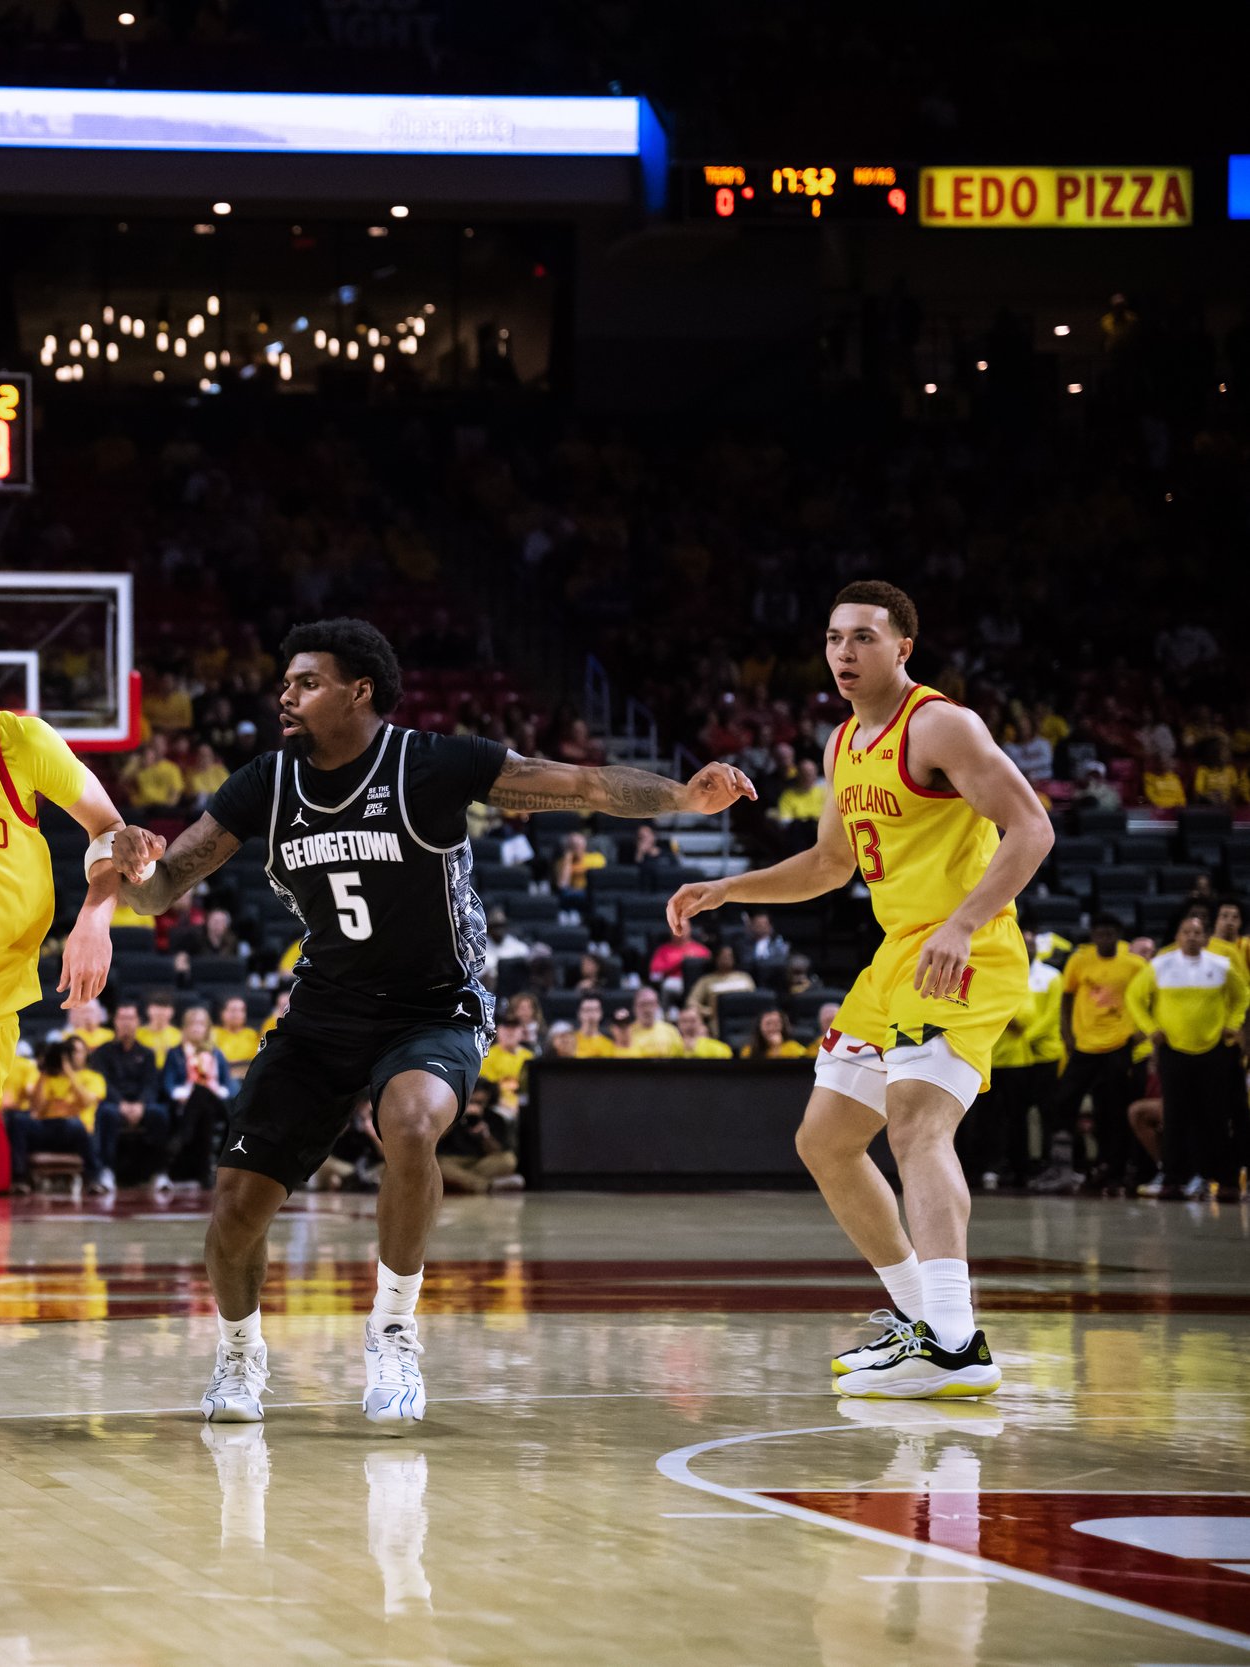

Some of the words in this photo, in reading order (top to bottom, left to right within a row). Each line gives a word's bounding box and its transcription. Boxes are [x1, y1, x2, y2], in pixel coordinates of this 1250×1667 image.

[772, 167, 836, 196] 17:52
[926, 175, 1038, 219] LEDO
[1056, 175, 1188, 219] PIZZA
[366, 791, 391, 801] CHANGE
[368, 786, 377, 794] BE
[378, 785, 390, 793] THE
[363, 807, 388, 817] EAST
[366, 802, 383, 810] BIG
[280, 830, 404, 872] GEORGETOWN
[327, 871, 373, 942] 5
